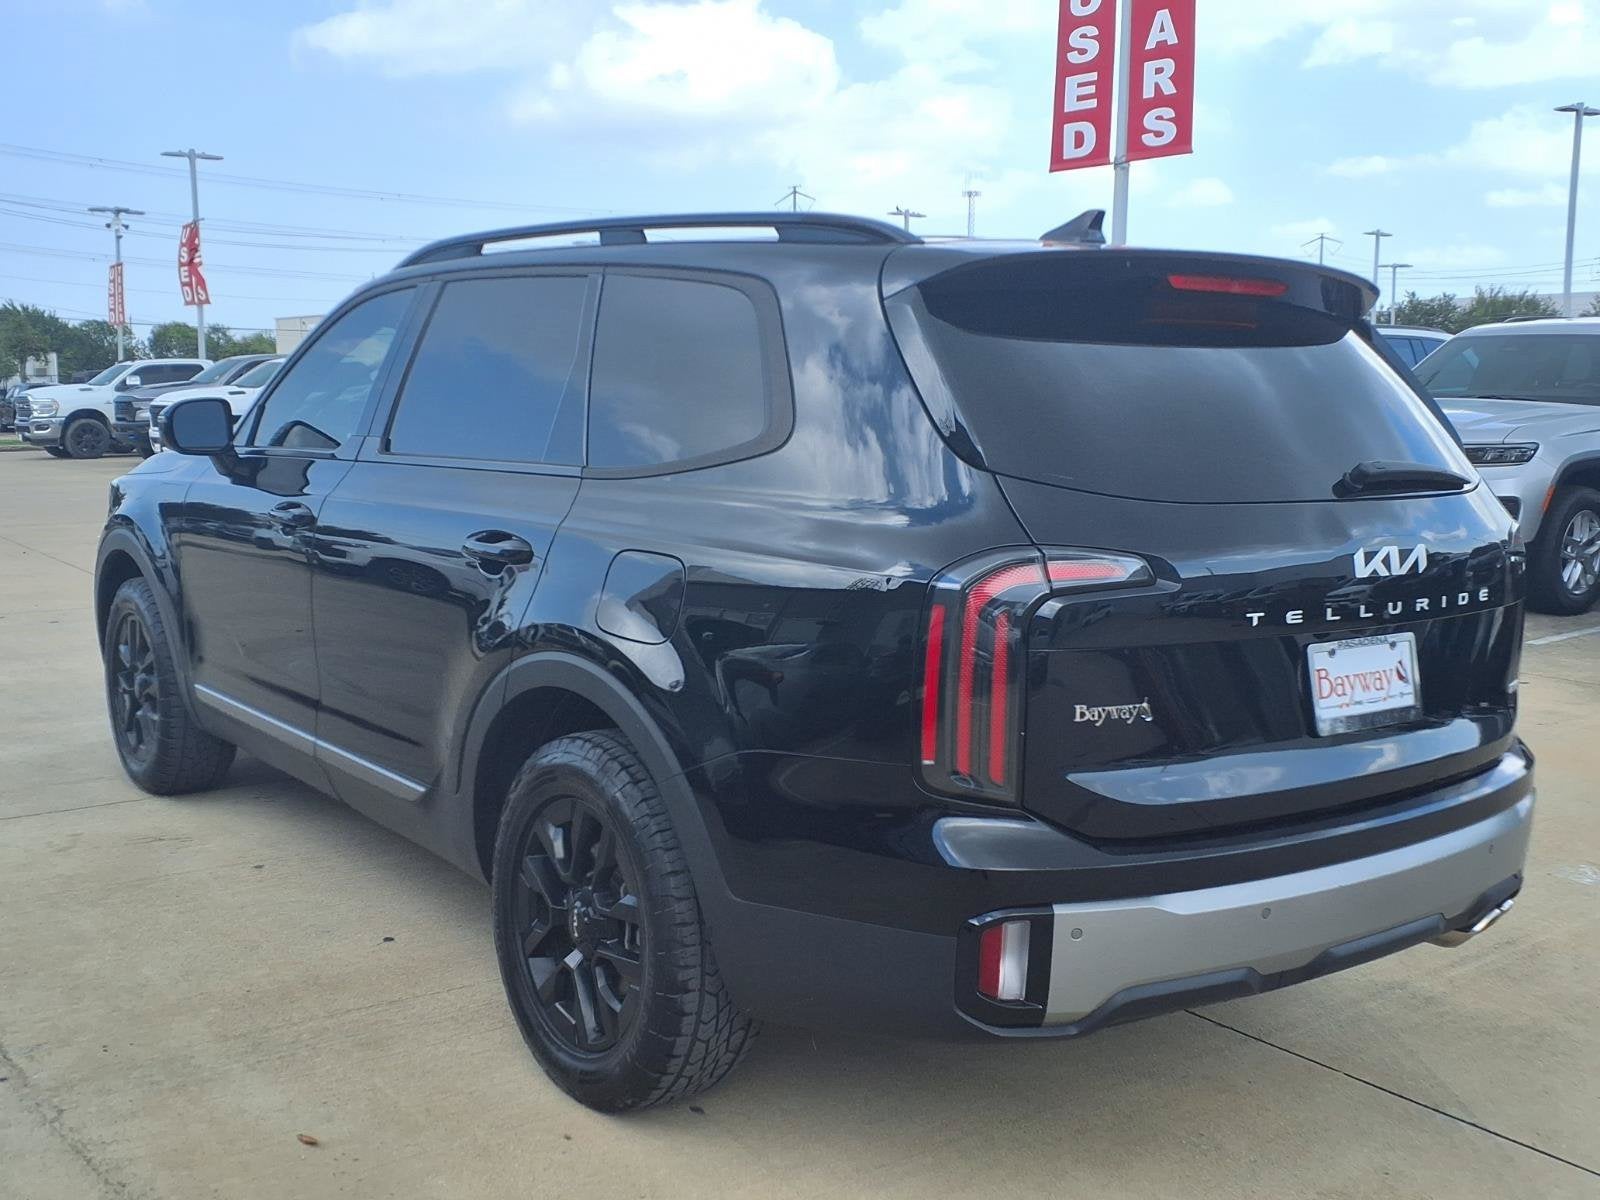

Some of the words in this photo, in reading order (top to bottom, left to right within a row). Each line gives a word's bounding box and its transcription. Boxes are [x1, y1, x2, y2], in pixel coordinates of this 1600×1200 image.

[180, 227, 192, 302] USED
[1353, 543, 1428, 579] KIA
[1246, 588, 1491, 627] TELLURIDE
[1337, 636, 1389, 650] PASADENA
[1314, 667, 1394, 706] Bayway
[1073, 704, 1141, 727] Bayway
